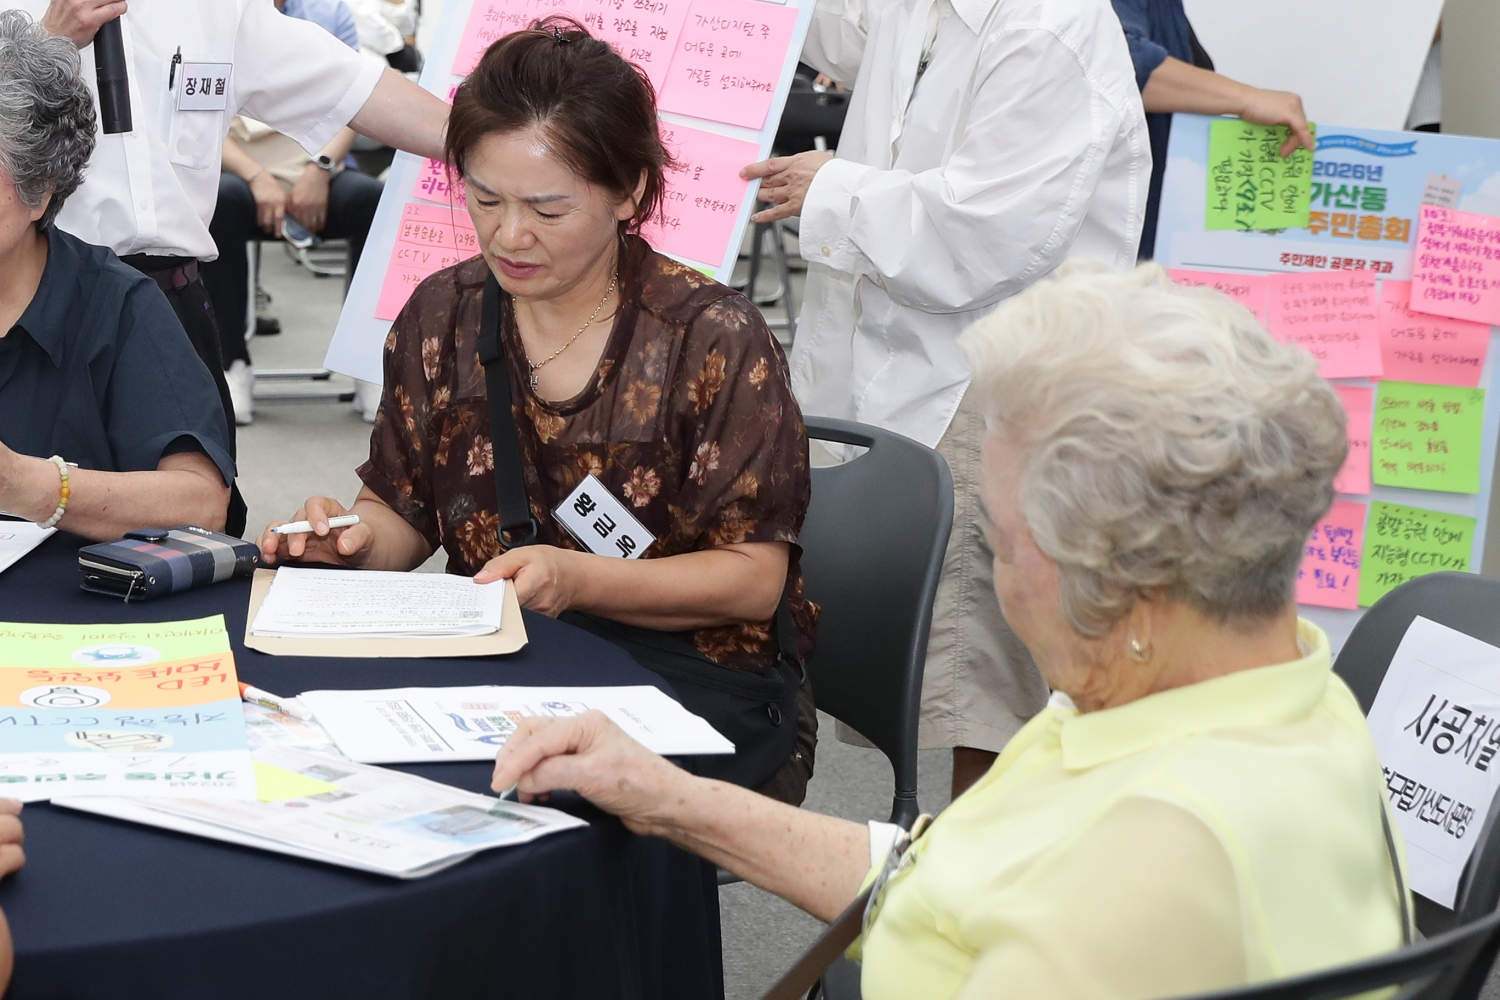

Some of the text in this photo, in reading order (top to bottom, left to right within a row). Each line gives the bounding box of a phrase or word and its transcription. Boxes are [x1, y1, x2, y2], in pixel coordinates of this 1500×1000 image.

[584, 11, 604, 31] 배출
[613, 18, 638, 38] 장소를
[694, 14, 756, 37] 가산디지털
[185, 77, 226, 96] 장재철
[686, 68, 712, 87] 가로등
[1311, 160, 1384, 182] 2026년
[663, 189, 688, 202] CCTV
[1310, 182, 1388, 212] 가산동
[403, 223, 477, 247] 남부순환로 1298
[1307, 211, 1412, 243] 주민총회
[397, 249, 431, 264] CCTV
[1279, 252, 1394, 275] 주민제안 공론장 결과
[573, 491, 637, 559] 황금옥
[1432, 525, 1463, 544] 안에
[26, 657, 223, 684] 스마트 보안등
[155, 673, 228, 692] LED
